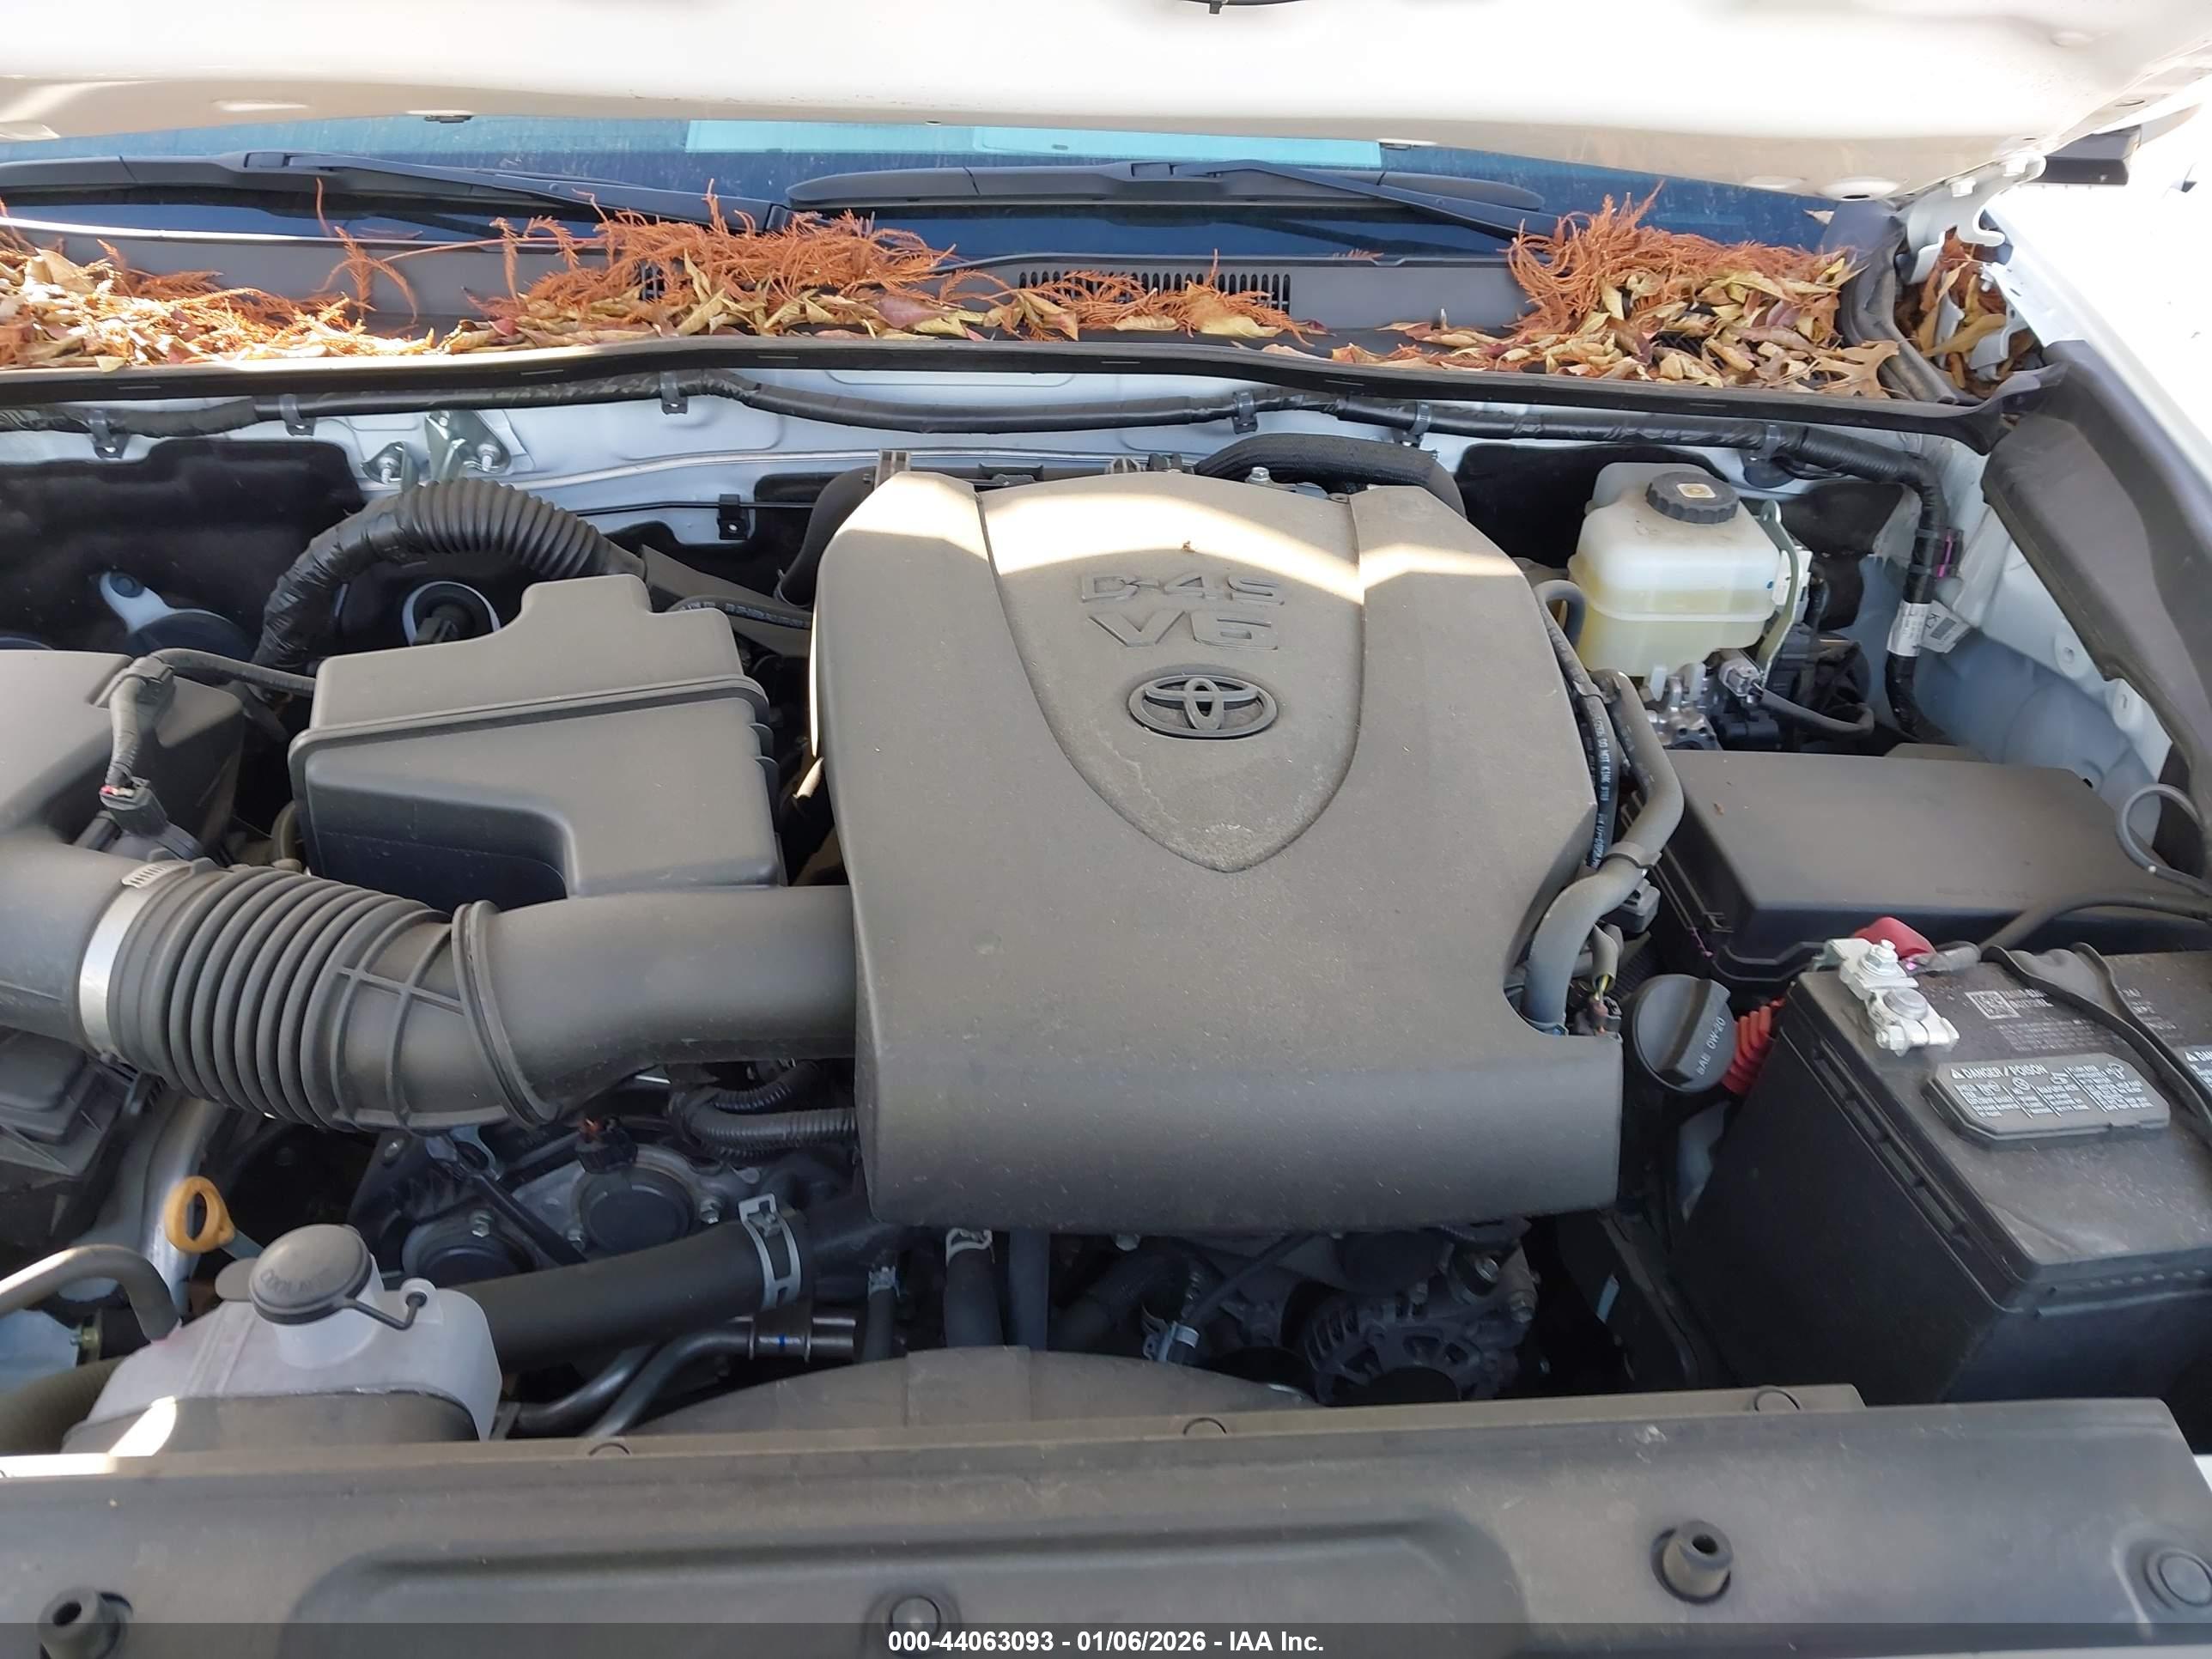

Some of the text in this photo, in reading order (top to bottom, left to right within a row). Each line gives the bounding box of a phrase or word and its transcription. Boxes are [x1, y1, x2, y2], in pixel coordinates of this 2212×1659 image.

[1081, 571, 1285, 606] D-4S
[1086, 609, 1279, 651] V6
[1960, 1066, 2005, 1079] DANGER
[2008, 1063, 2050, 1076] POISON
